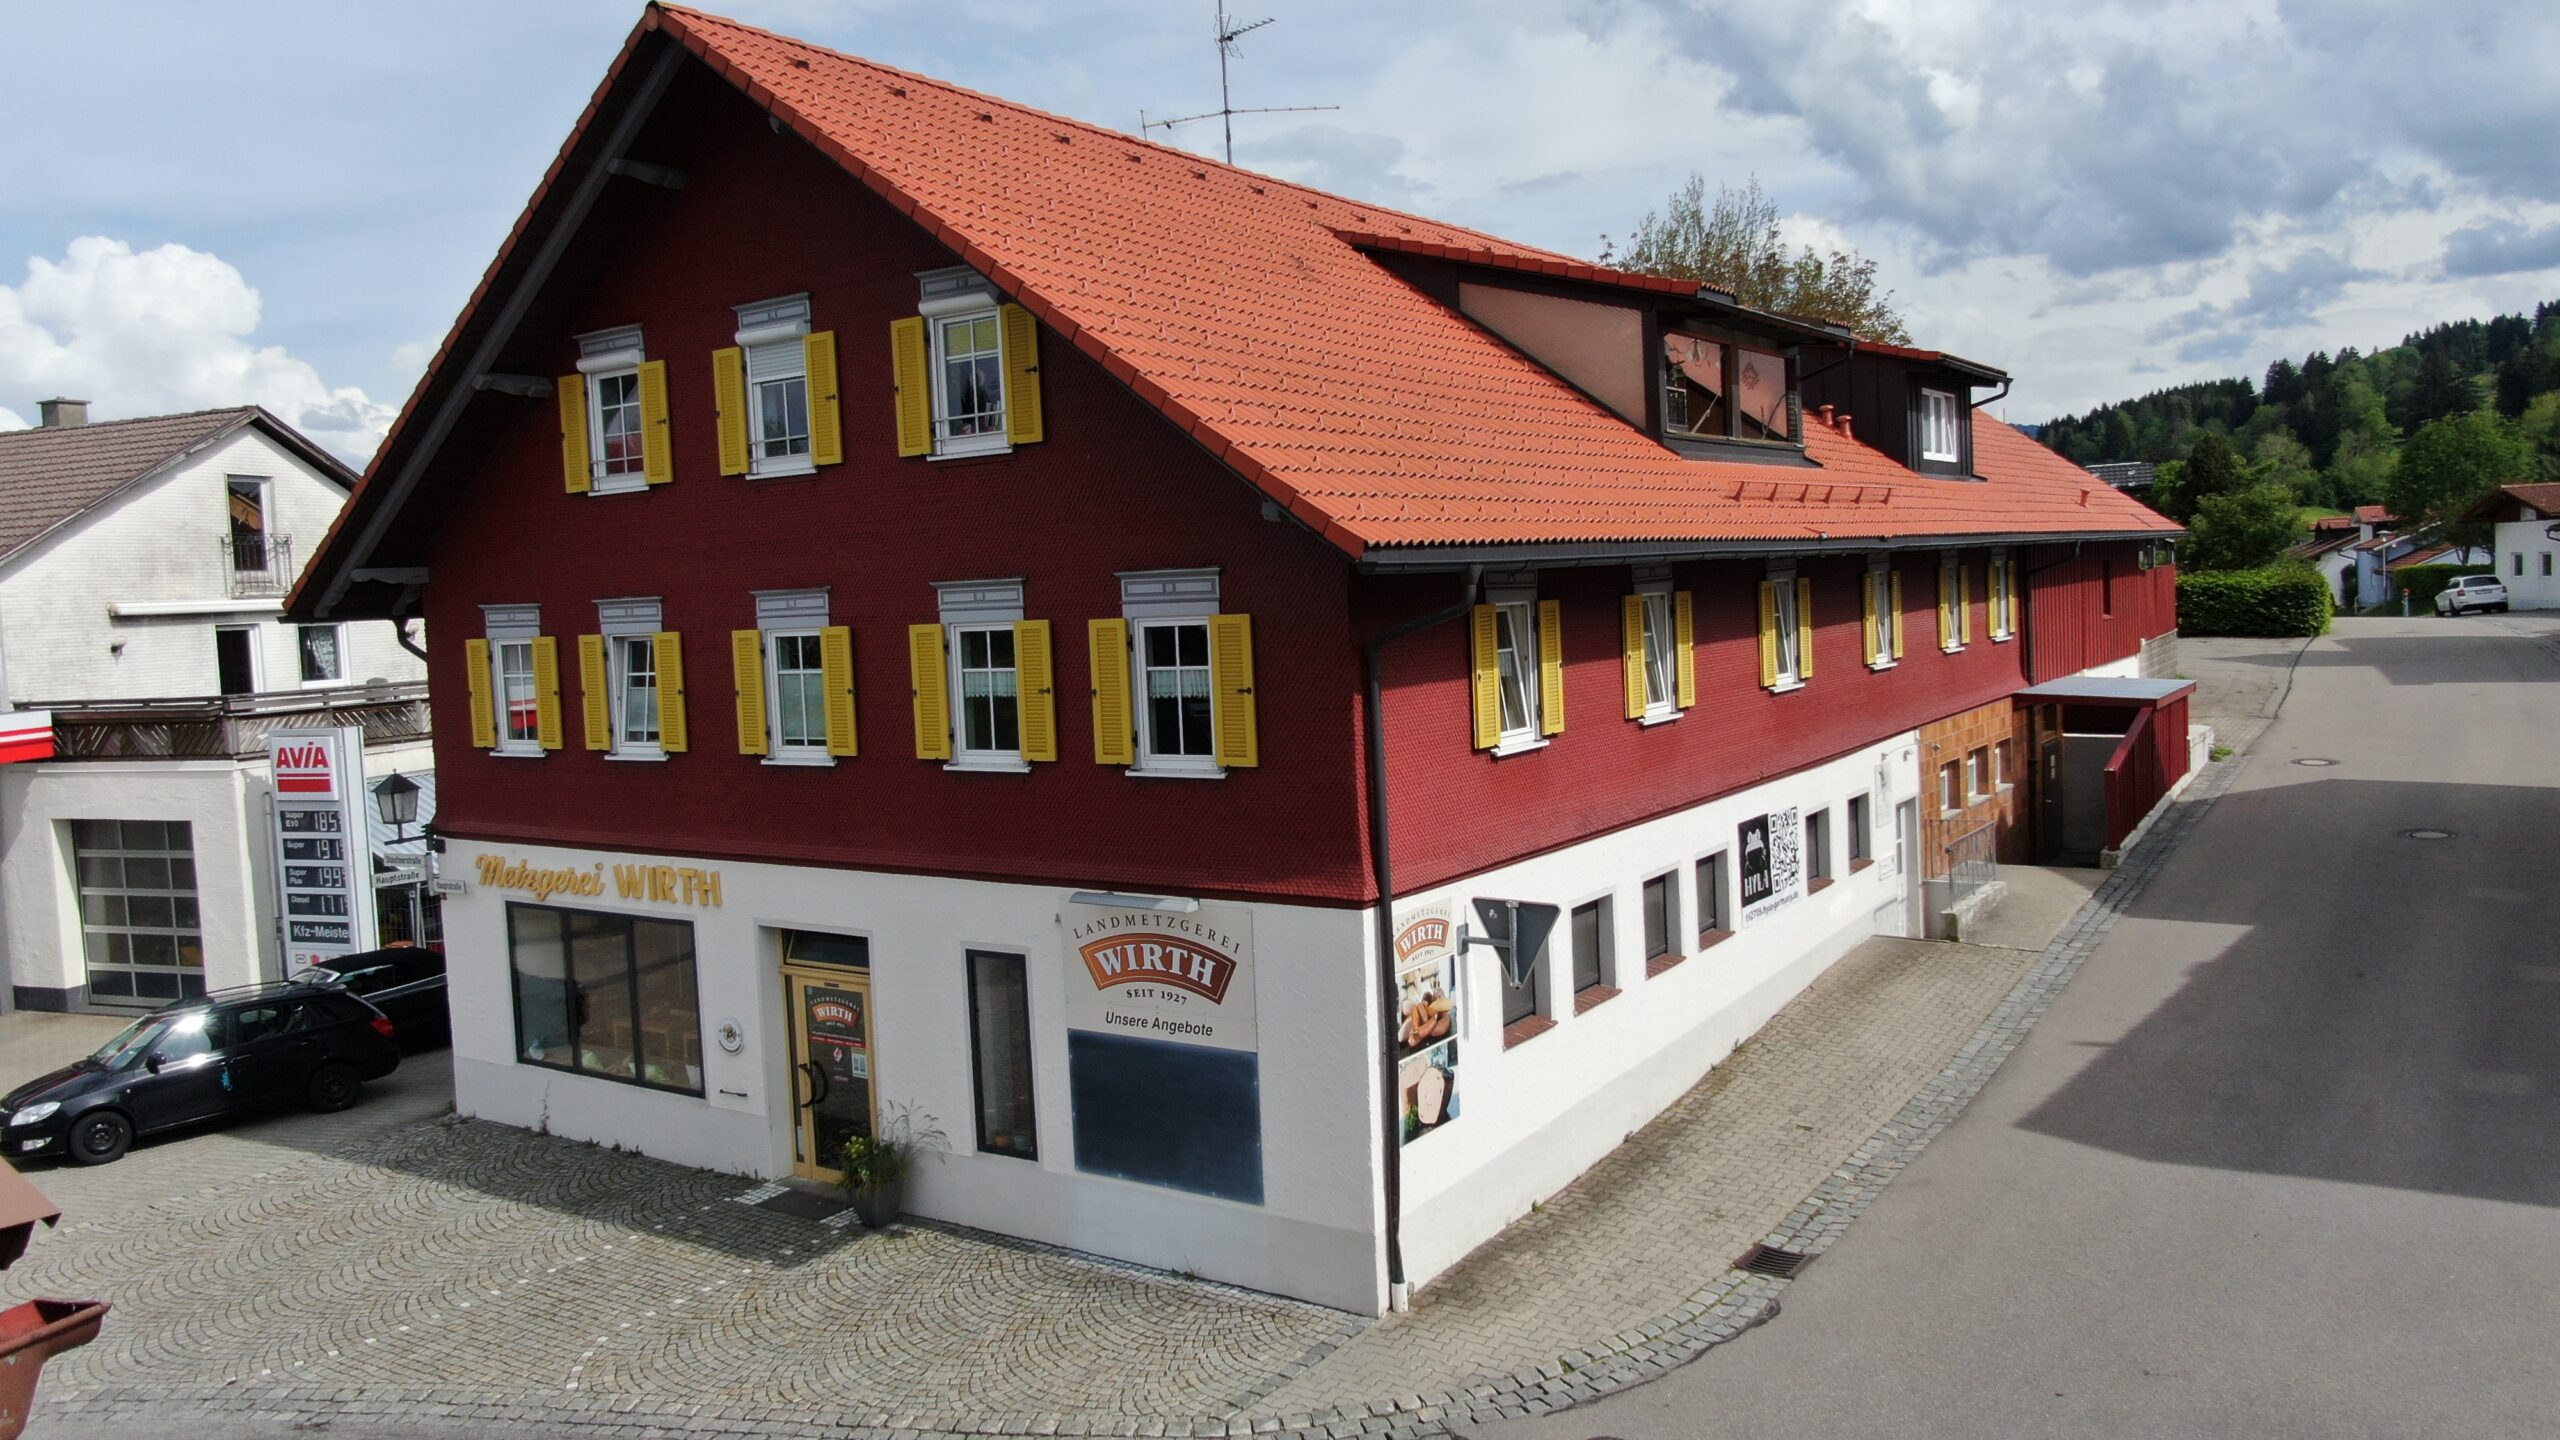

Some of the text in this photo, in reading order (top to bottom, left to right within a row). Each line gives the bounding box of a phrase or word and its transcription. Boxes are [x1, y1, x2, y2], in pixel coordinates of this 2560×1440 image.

[376, 871, 420, 884] Hauptstraße
[475, 853, 723, 907] Metzgerei WIRTH
[1744, 870, 1769, 898] HYLA
[1073, 914, 1240, 954] LANDMETZGEREI
[1400, 923, 1444, 953] WIRTH
[1094, 943, 1216, 987] WIRTH
[1126, 989, 1188, 1005] SEIT 1927
[817, 1006, 853, 1022] WIRTH
[1105, 1011, 1213, 1036] Unsere Angebote
